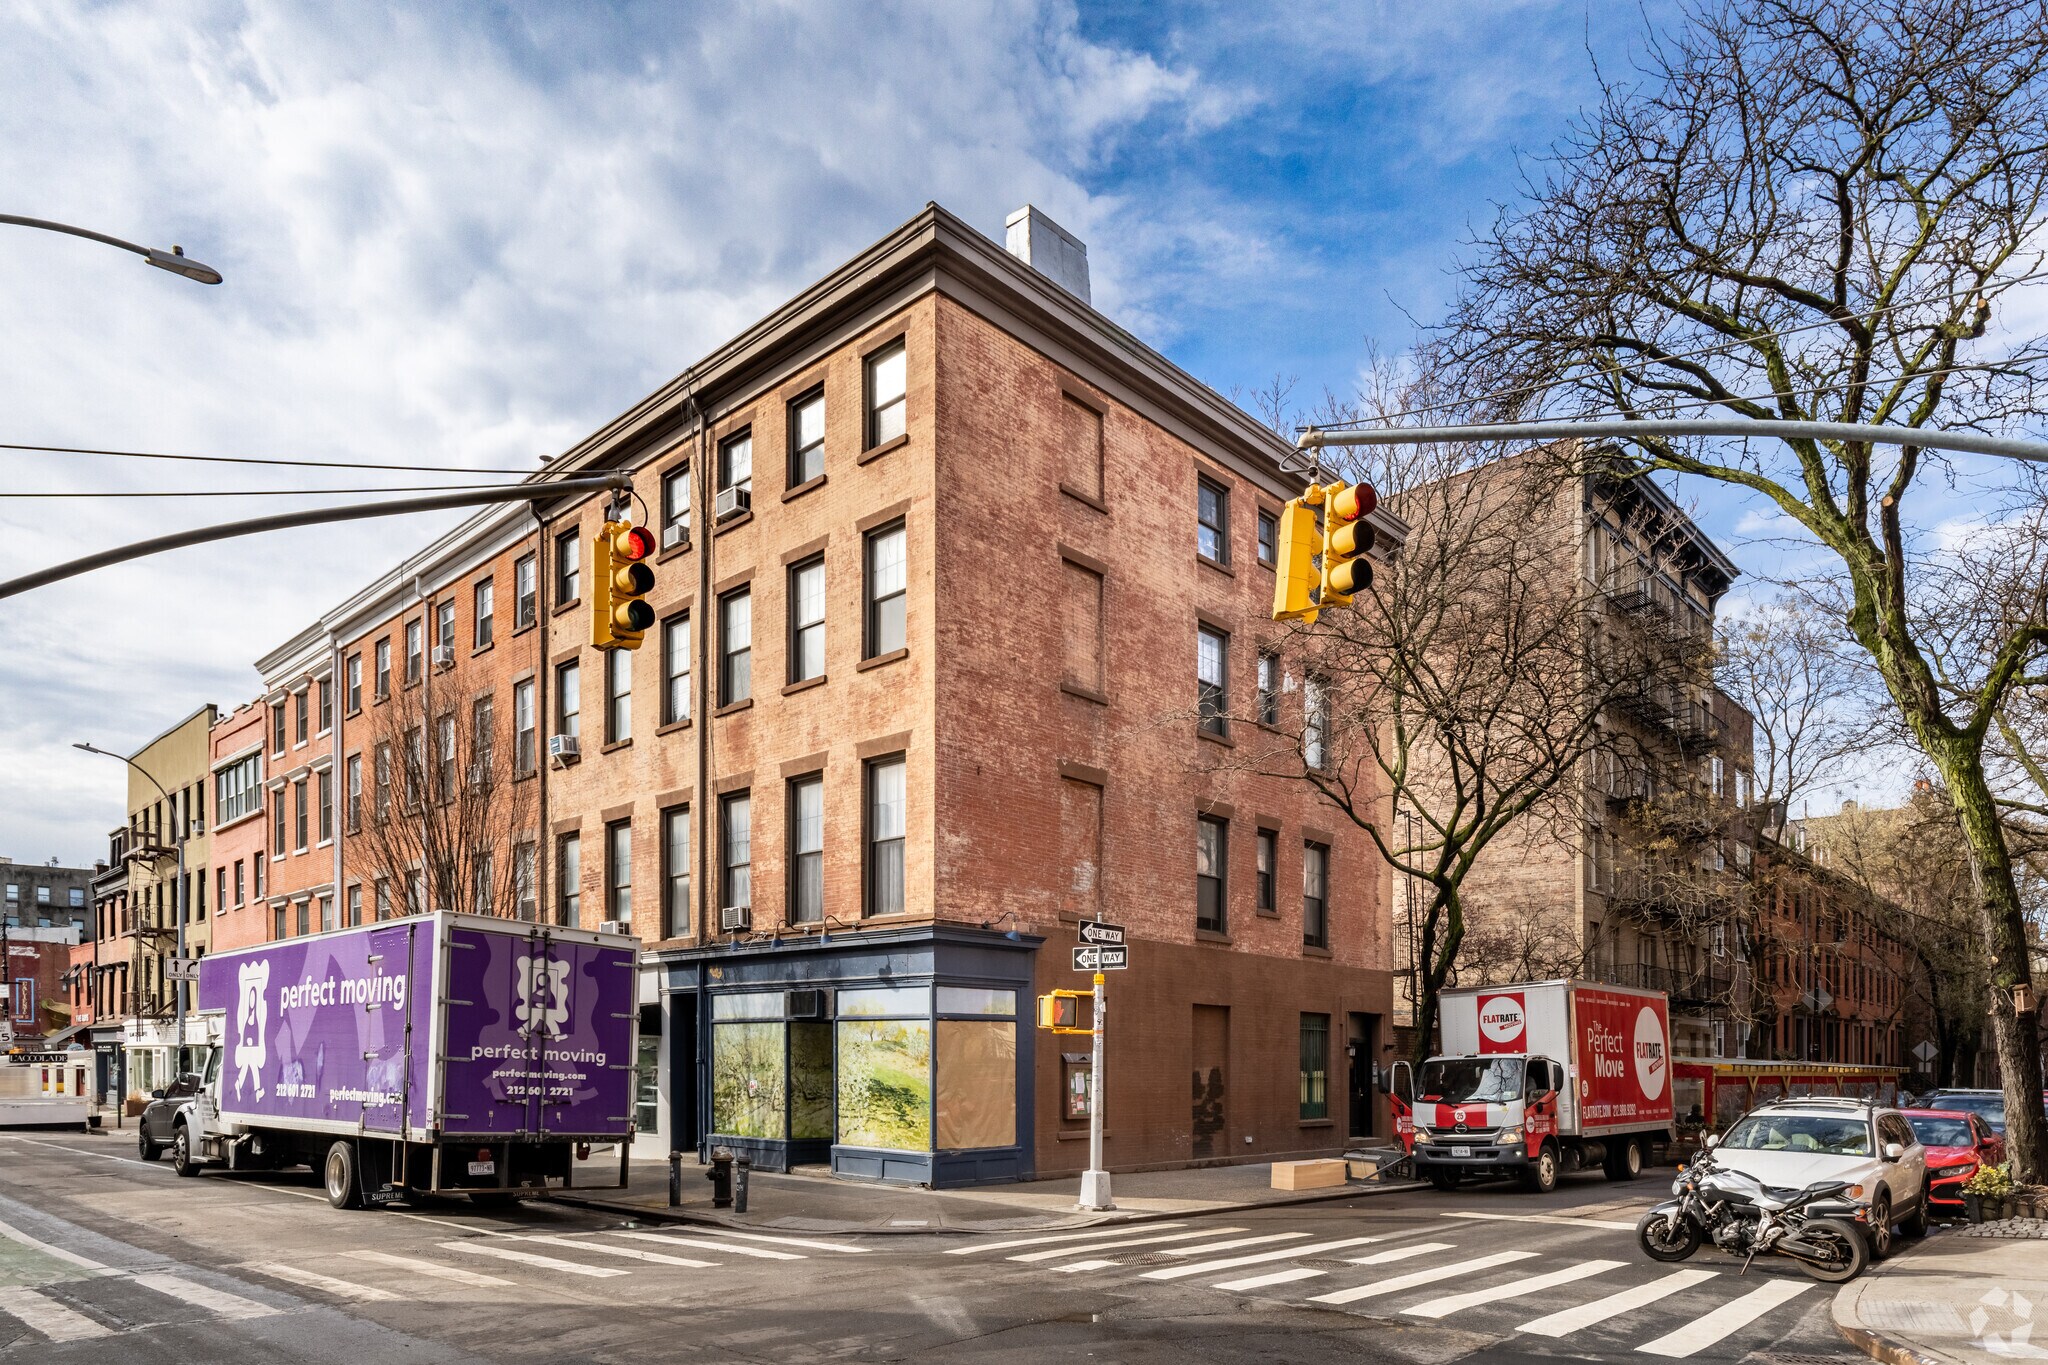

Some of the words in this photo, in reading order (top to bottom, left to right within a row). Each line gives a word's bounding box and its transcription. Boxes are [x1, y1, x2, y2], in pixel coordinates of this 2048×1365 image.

[1088, 928, 1102, 938] ONE
[1105, 931, 1119, 940] WAY
[1081, 954, 1096, 963] ONE
[1104, 953, 1120, 962] WAY
[280, 975, 336, 1017] perfect
[340, 966, 406, 1011] moving
[1483, 1013, 1518, 1024] FLATRATE
[1593, 1020, 1602, 1032] The
[0, 1033, 10, 1042] 5
[1587, 1027, 1624, 1053] Perfect
[471, 1044, 538, 1061] perfect
[544, 1048, 607, 1067] moving
[1636, 1042, 1661, 1059] FLATRATE
[1594, 1053, 1625, 1078] Move
[492, 1068, 587, 1081] perfecmoving.com
[276, 1083, 287, 1097] 212
[288, 1084, 298, 1097] 601
[301, 1085, 315, 1098] 2721
[506, 1086, 525, 1095] 212
[549, 1087, 573, 1096] 2721
[1456, 1112, 1464, 1120] 25
[371, 1192, 404, 1201] SUPREME
